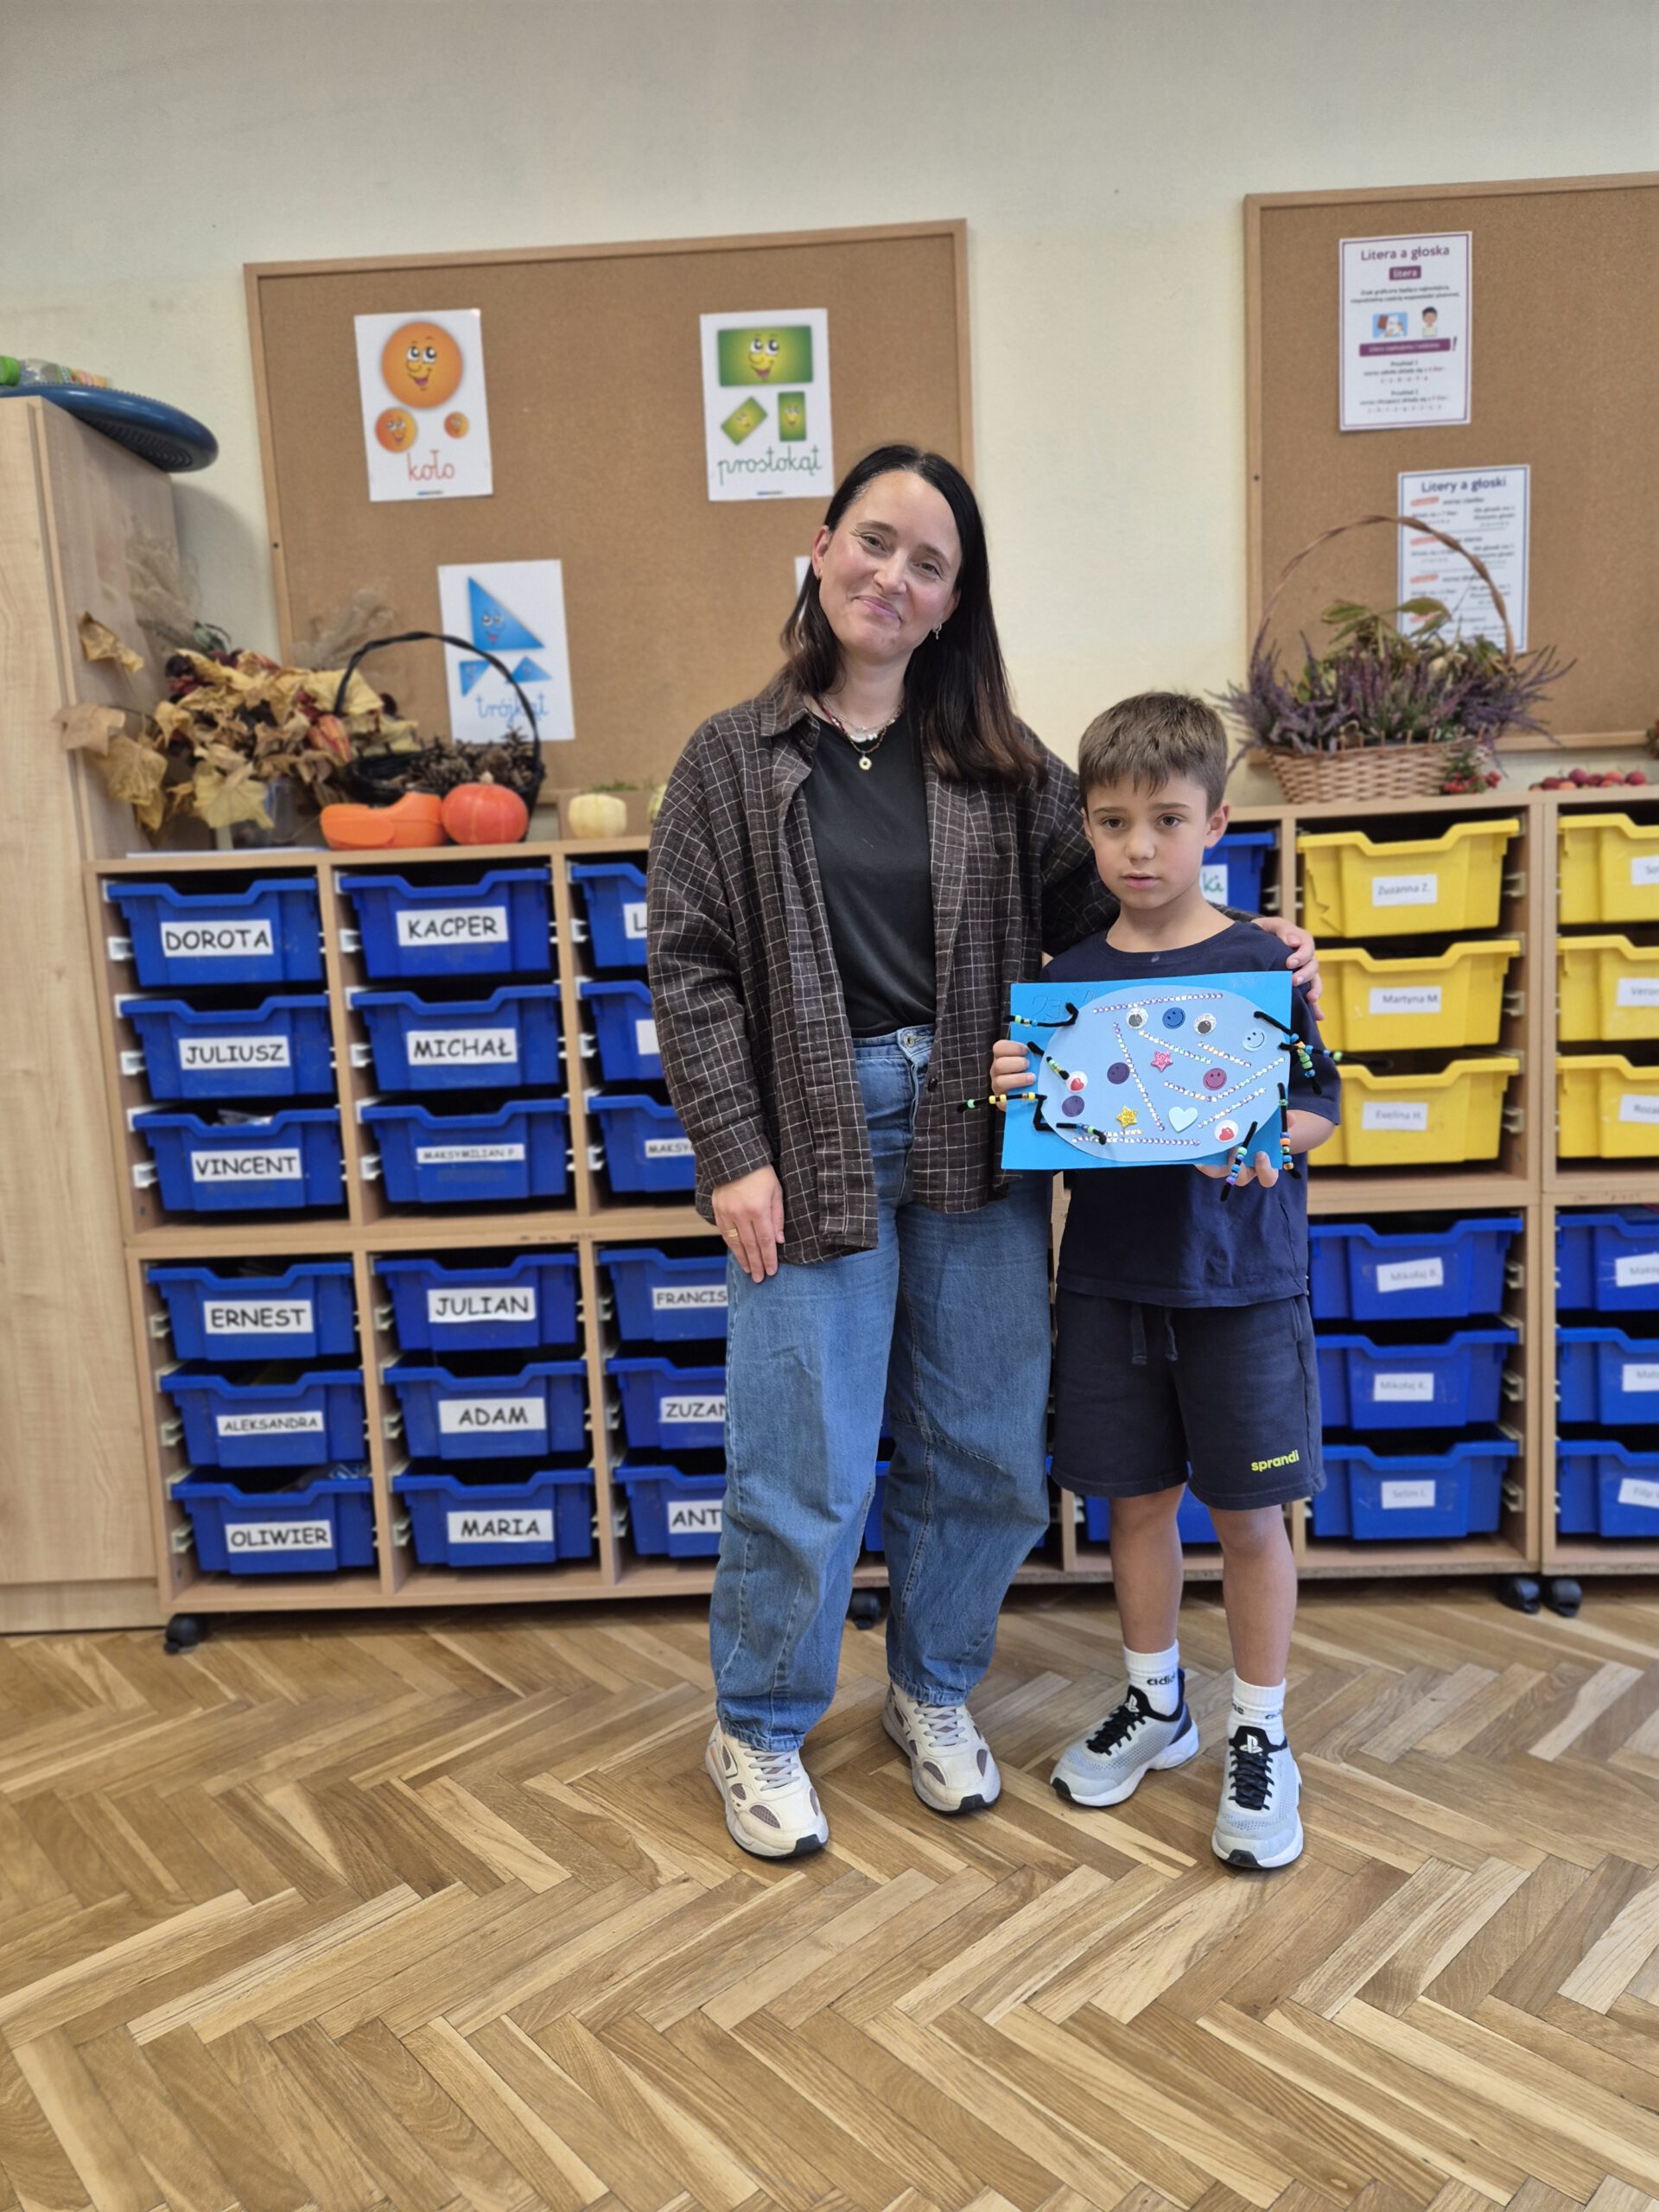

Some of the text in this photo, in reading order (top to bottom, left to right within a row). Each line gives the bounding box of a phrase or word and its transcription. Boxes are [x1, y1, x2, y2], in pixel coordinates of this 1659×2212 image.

[1360, 245, 1450, 261] Litera a głoska
[1392, 268, 1418, 278] litera
[407, 449, 455, 481] koło
[717, 444, 823, 486] prostokąt
[1421, 475, 1507, 493] Litery a głoski
[408, 915, 499, 938] KACPER
[165, 929, 270, 950] DOROTA
[1382, 994, 1425, 1005] Martyna
[186, 1044, 284, 1064] JULIUSZ
[413, 1037, 512, 1058] MICHAŁ
[195, 1155, 296, 1176] VINCENT
[435, 1295, 529, 1316] JULIAN
[211, 1307, 306, 1327] ERNEST
[224, 1416, 318, 1432] ALEKSANDRA
[458, 1407, 528, 1427] ADAM
[1250, 1449, 1300, 1472] sprandi
[672, 1508, 722, 1527] ANT
[231, 1528, 328, 1548] OLIWIER
[461, 1518, 540, 1538] MARIA
